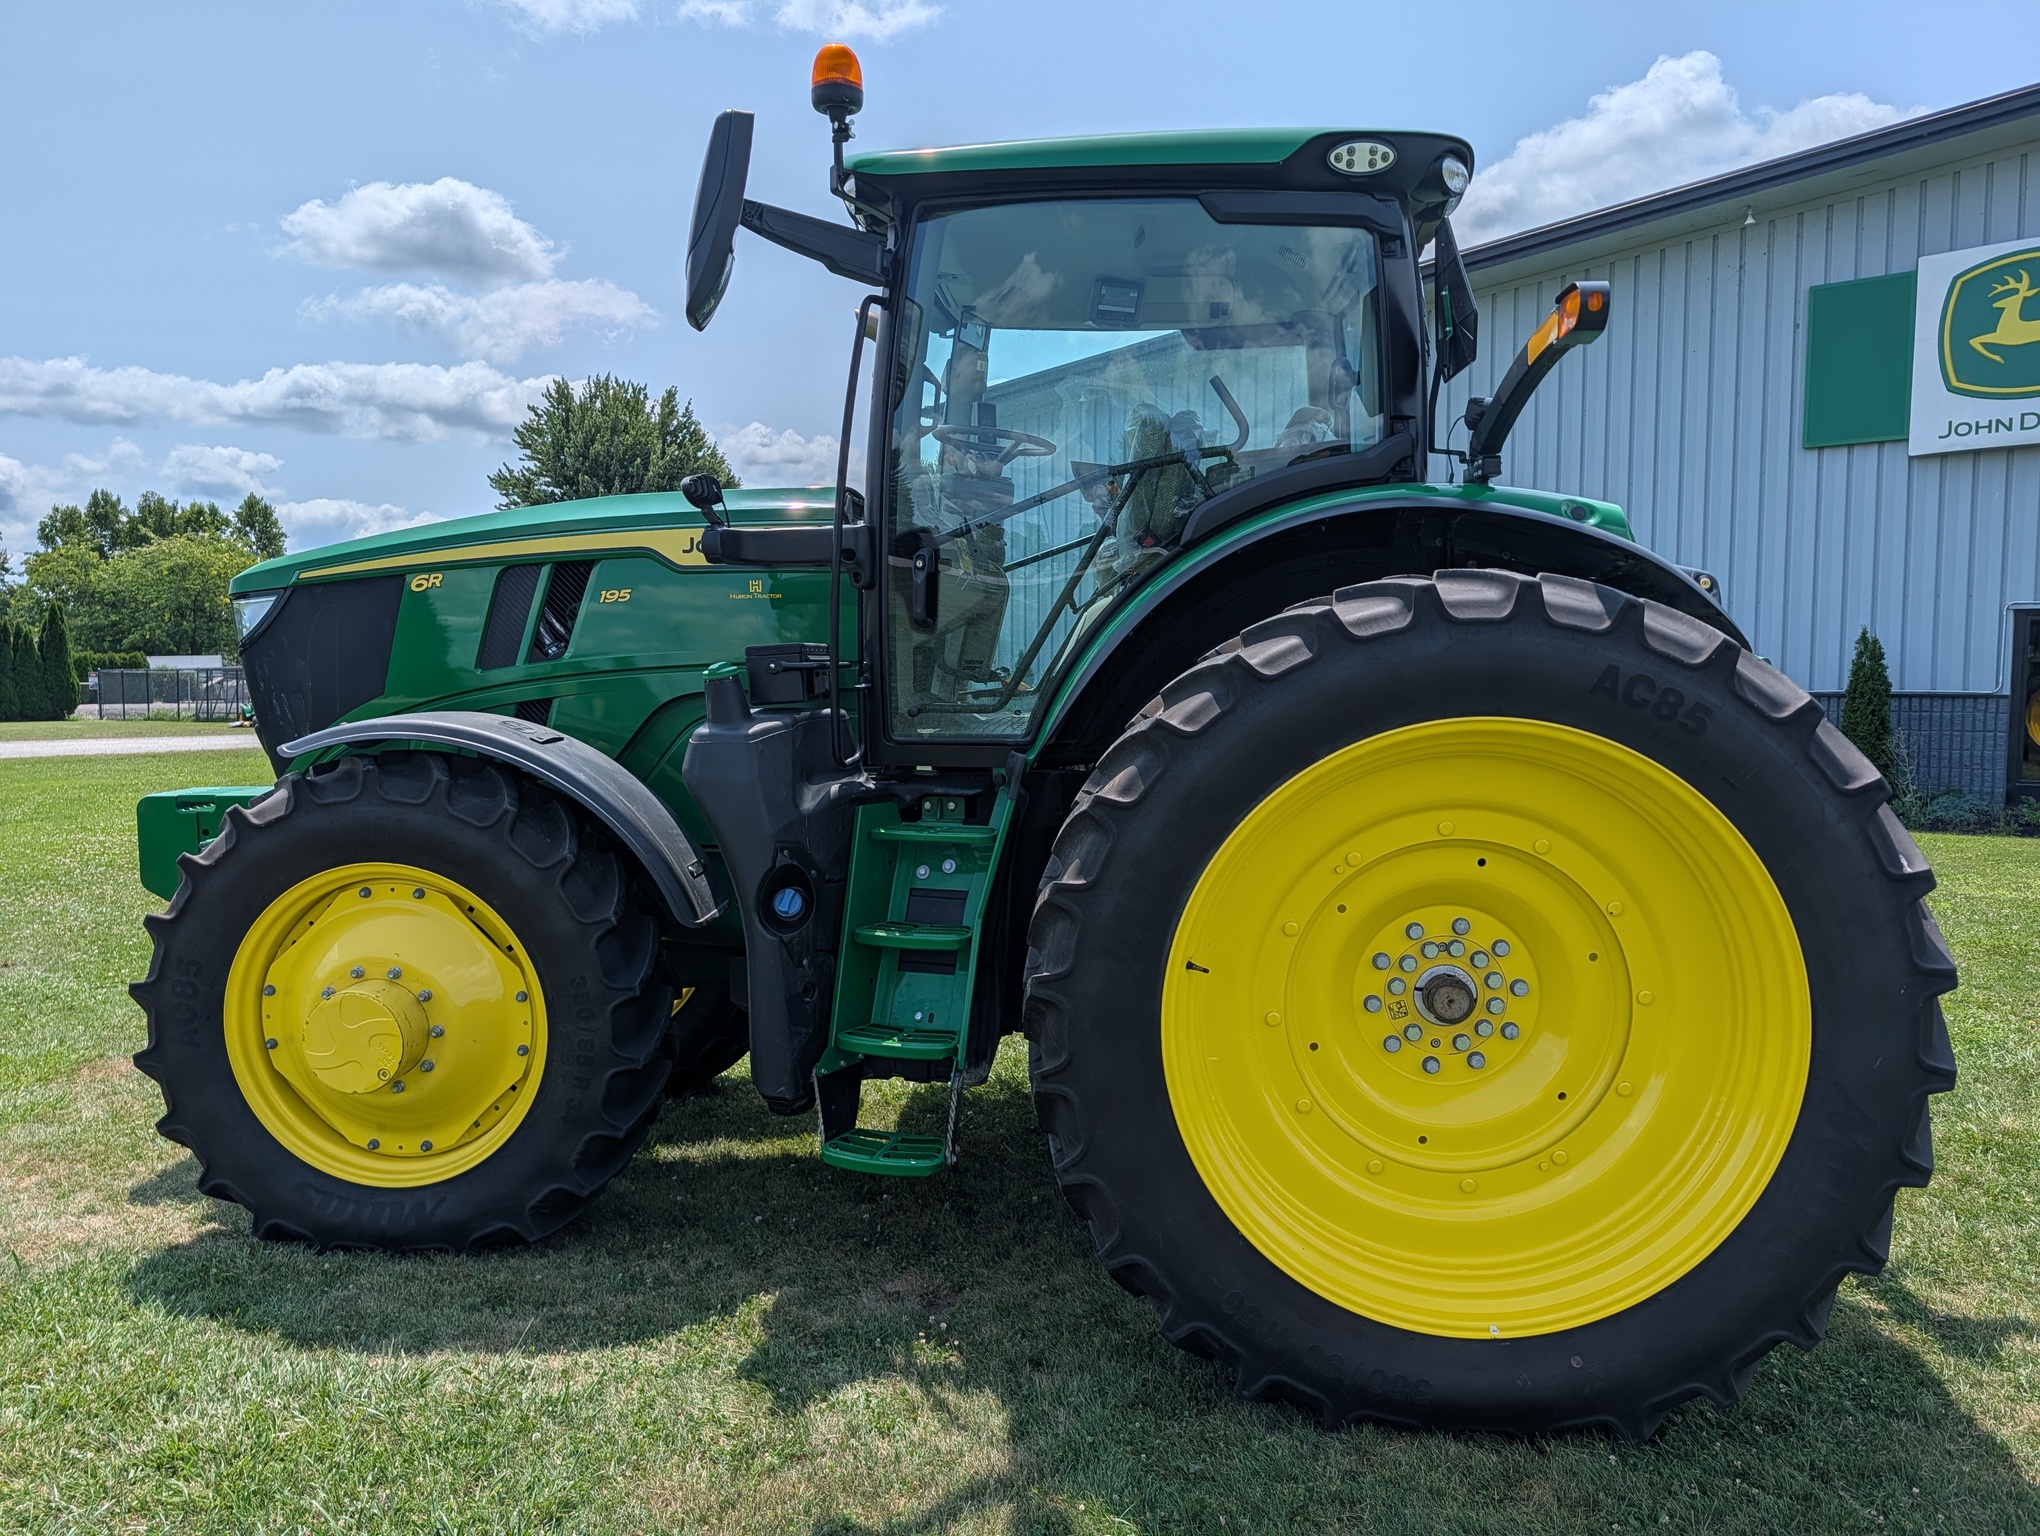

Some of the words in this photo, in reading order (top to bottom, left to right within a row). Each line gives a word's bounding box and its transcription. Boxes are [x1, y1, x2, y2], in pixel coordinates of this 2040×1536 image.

[1938, 416, 2013, 440] JOHN
[410, 573, 444, 592] 6R
[599, 588, 633, 604] 195
[1589, 663, 1715, 737] AC85
[165, 957, 204, 1050] AC85
